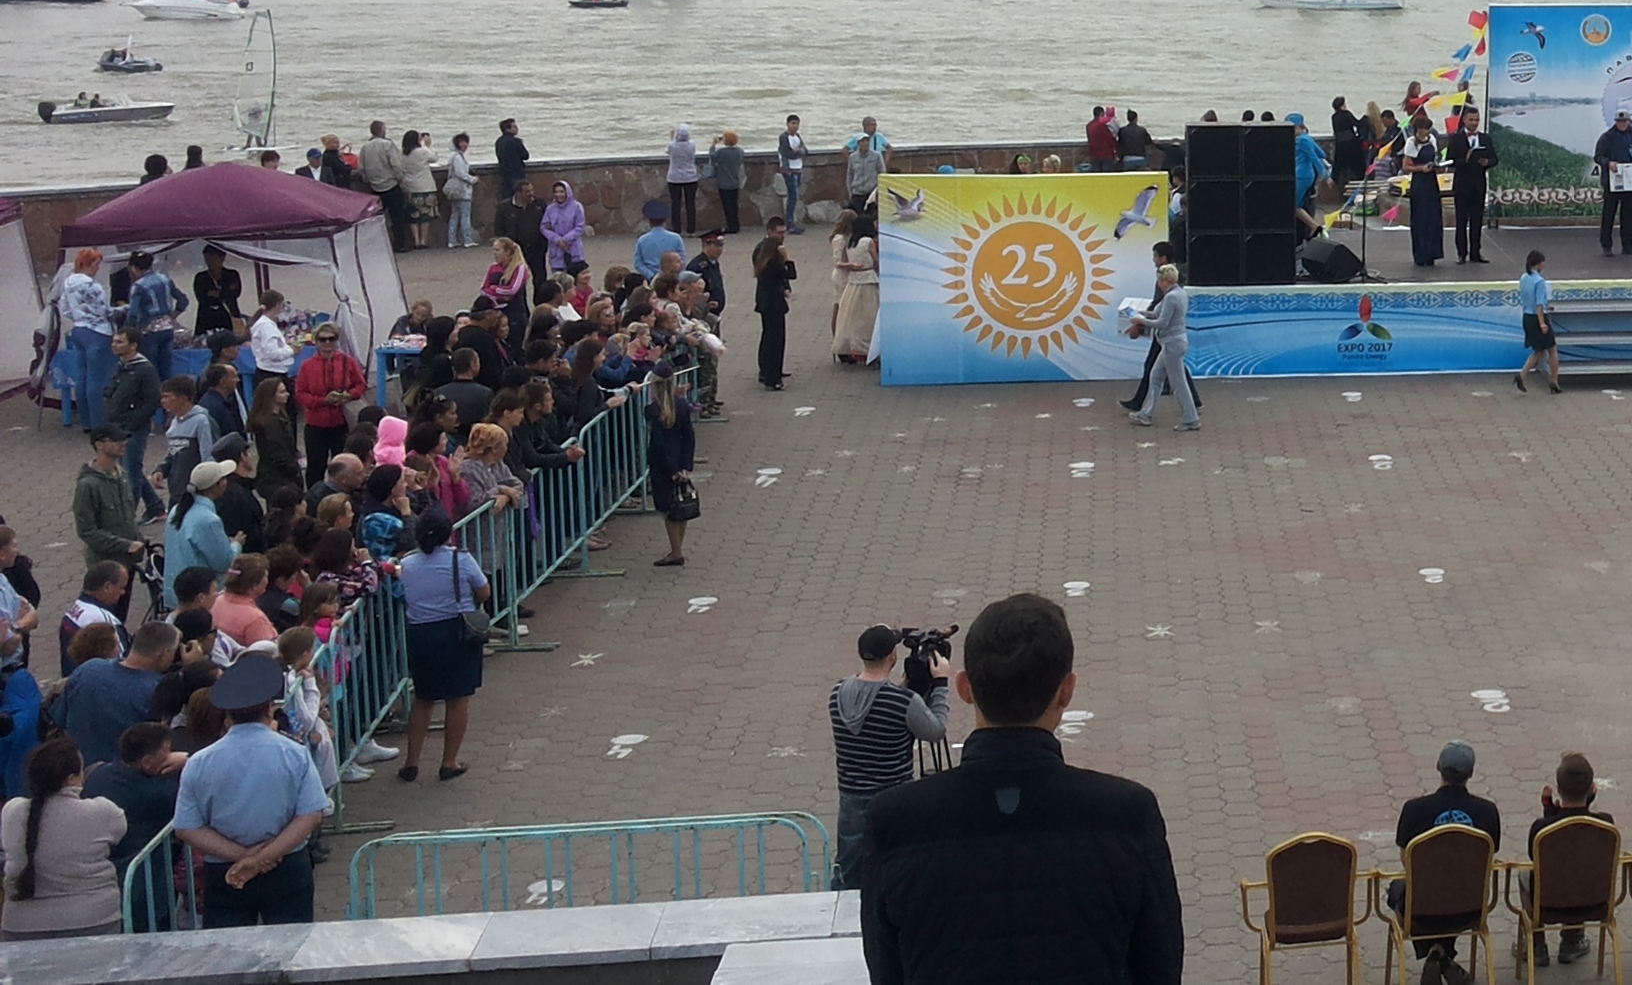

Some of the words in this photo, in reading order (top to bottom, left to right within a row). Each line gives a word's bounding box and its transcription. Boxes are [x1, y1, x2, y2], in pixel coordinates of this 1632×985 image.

[1000, 243, 1058, 288] 25
[1337, 342, 1365, 353] EXPO
[1367, 342, 1393, 352] 2017
